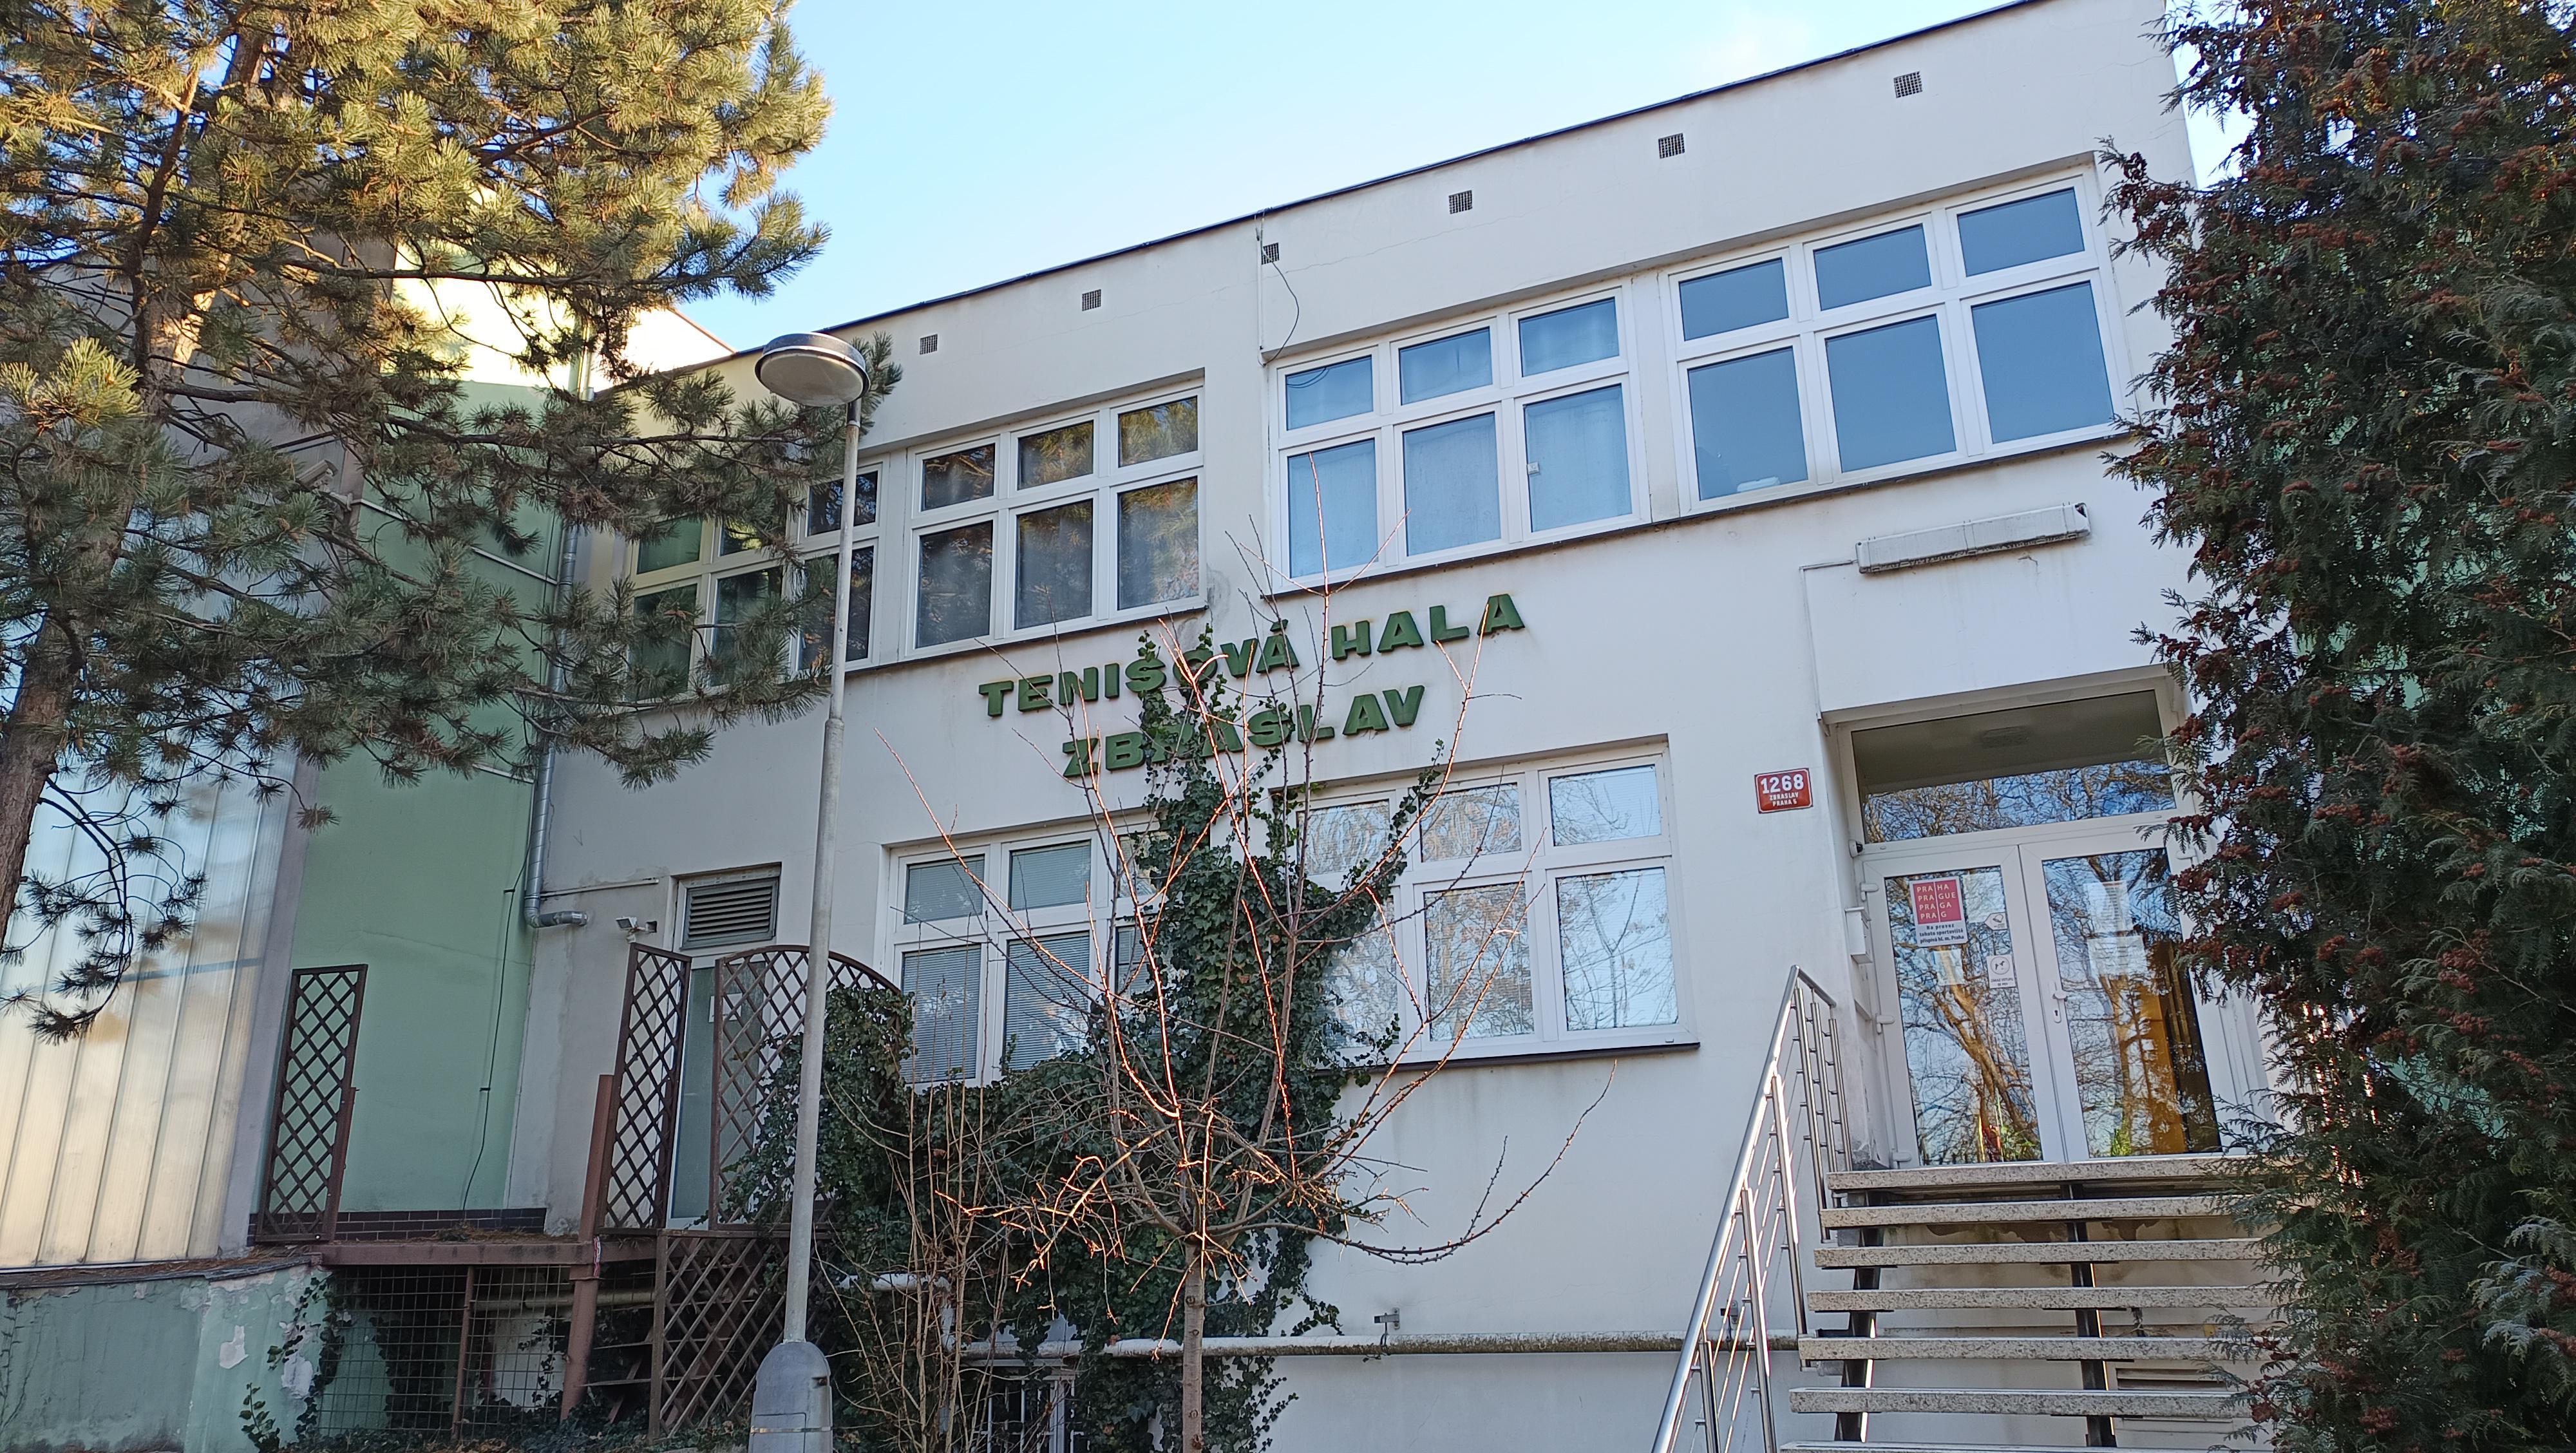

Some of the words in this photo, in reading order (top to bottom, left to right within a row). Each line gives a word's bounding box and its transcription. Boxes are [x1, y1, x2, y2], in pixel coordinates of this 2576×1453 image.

[1331, 593, 1525, 660] HALA
[1761, 774, 1804, 794] 1268
[1770, 792, 1799, 801] ZBRASLAV
[1772, 799, 1792, 807] PRAHA
